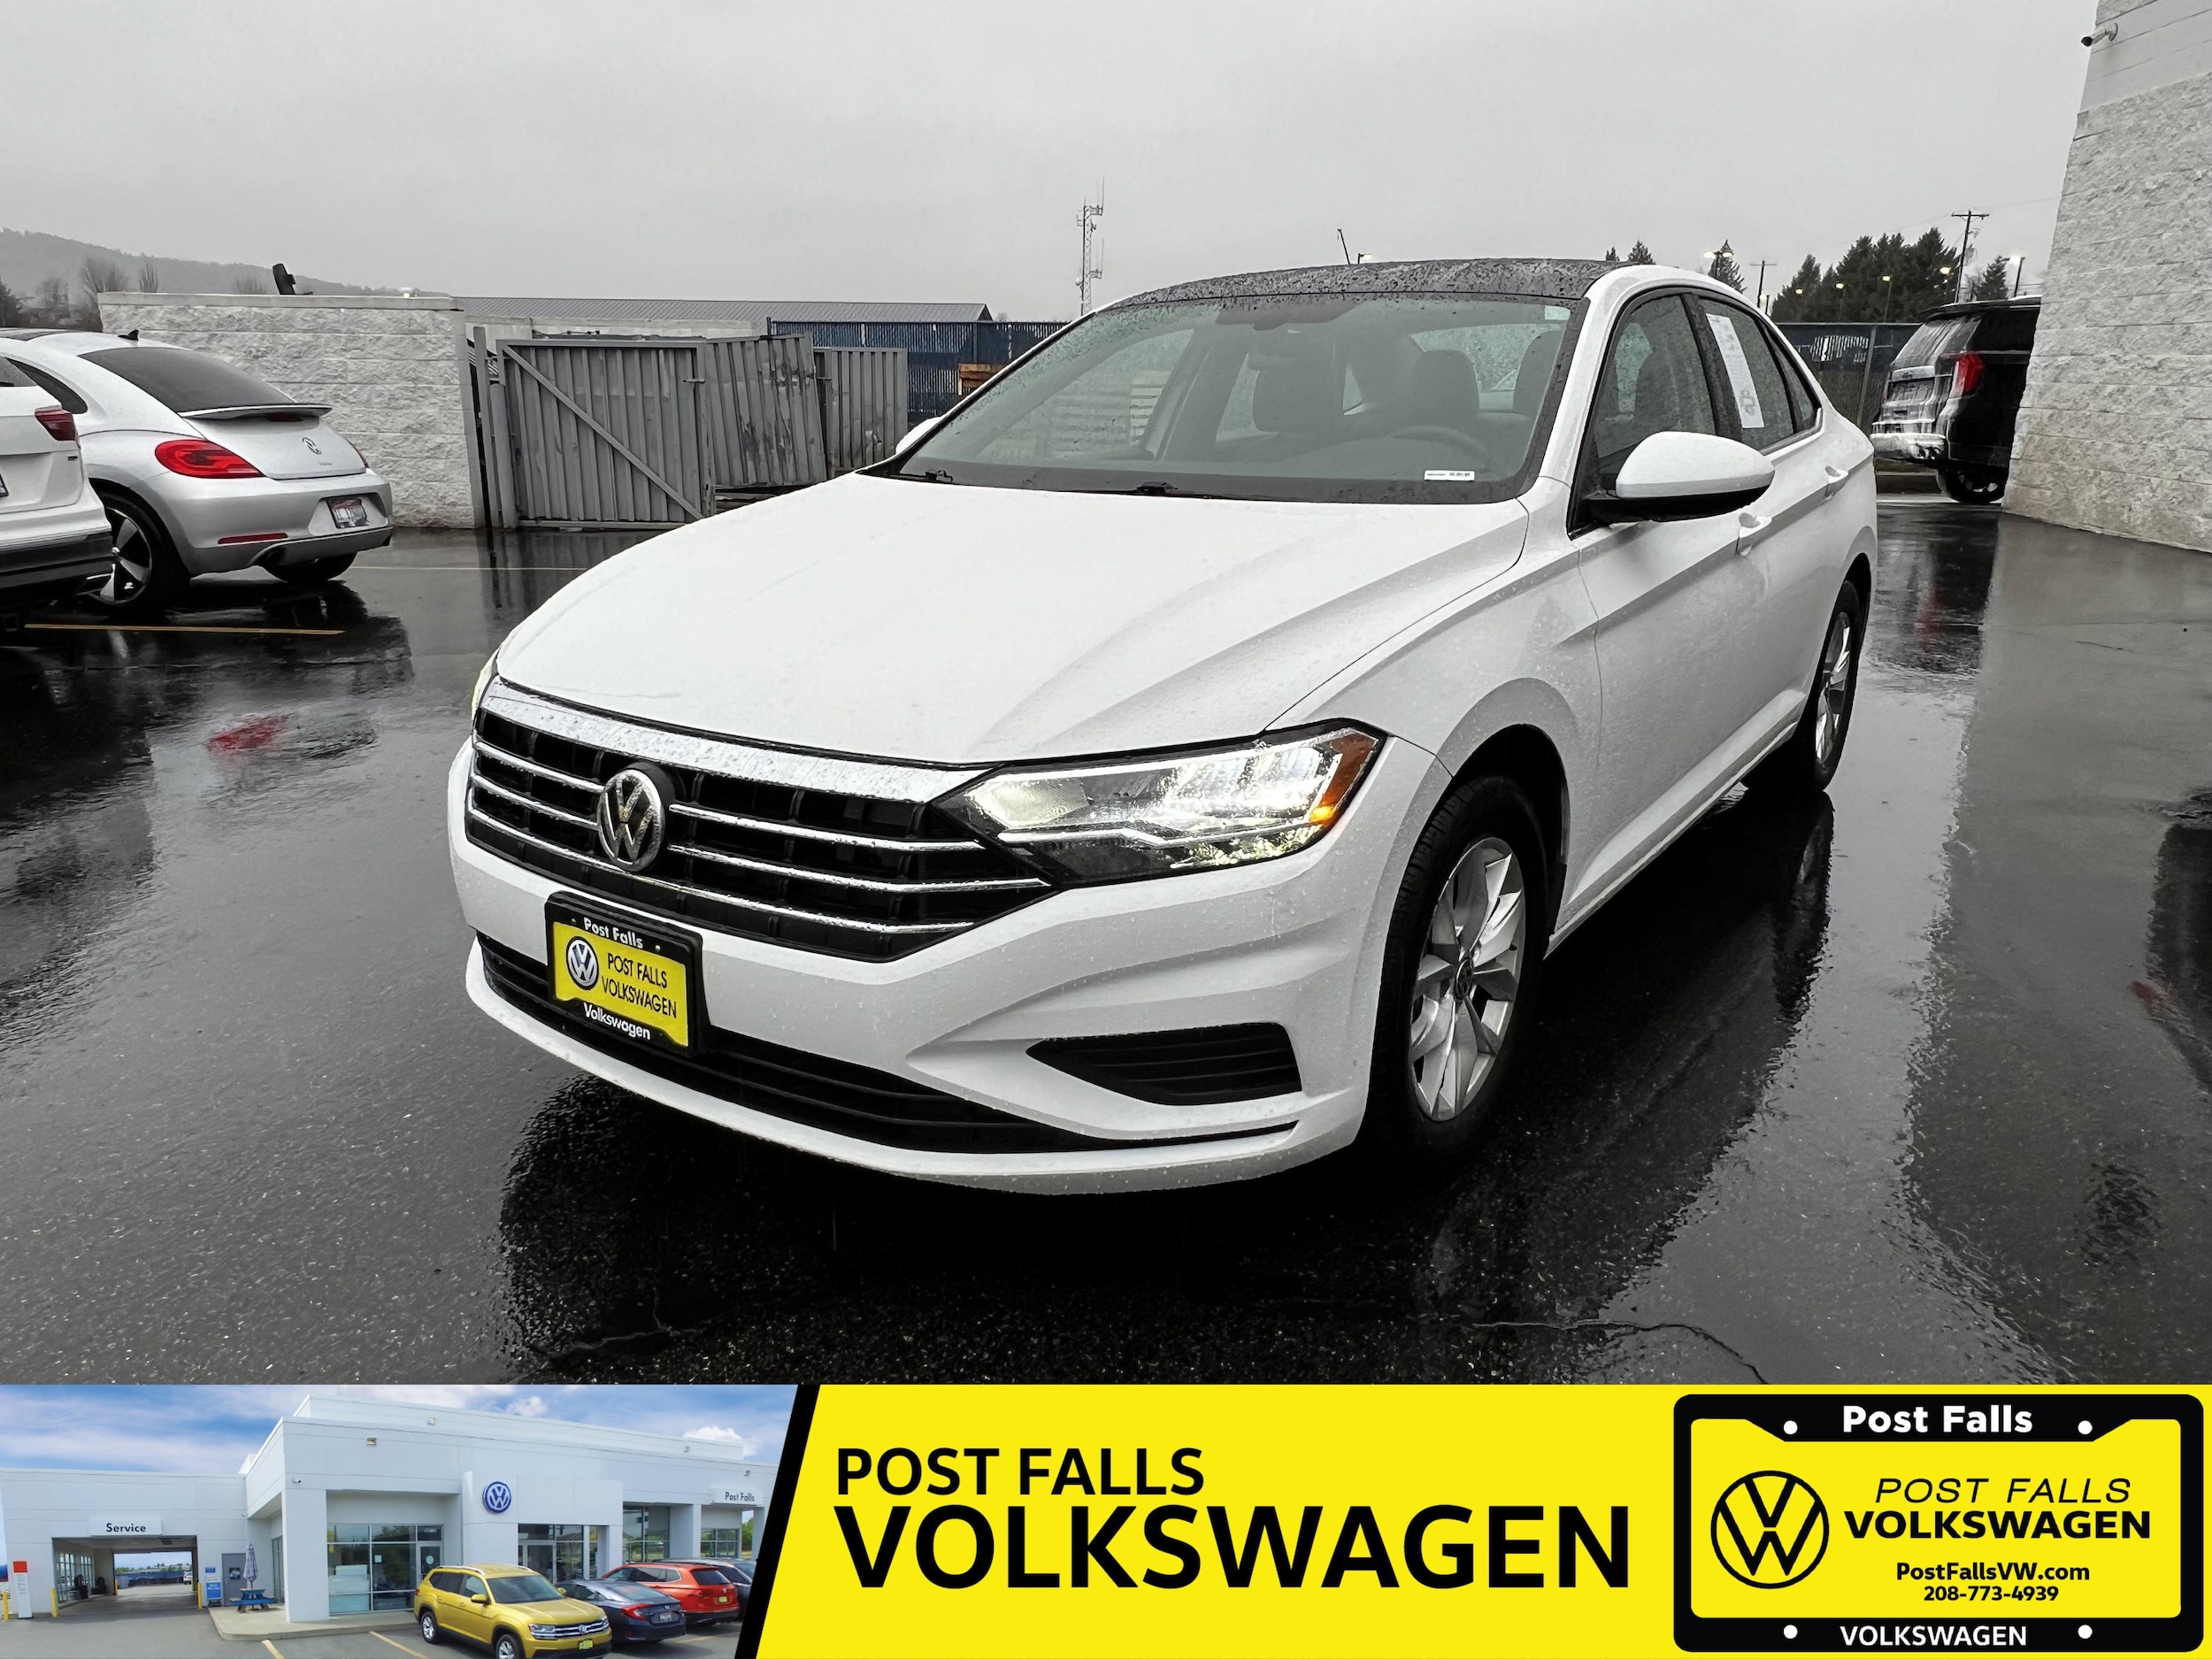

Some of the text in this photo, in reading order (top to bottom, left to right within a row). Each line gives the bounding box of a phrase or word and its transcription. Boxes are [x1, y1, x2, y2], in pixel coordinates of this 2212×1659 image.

[584, 917, 643, 949] Post Falls
[607, 952, 668, 989] POST FALLS
[602, 975, 677, 1019] VOLKSWAGEN
[583, 1002, 651, 1041] Volkswagen
